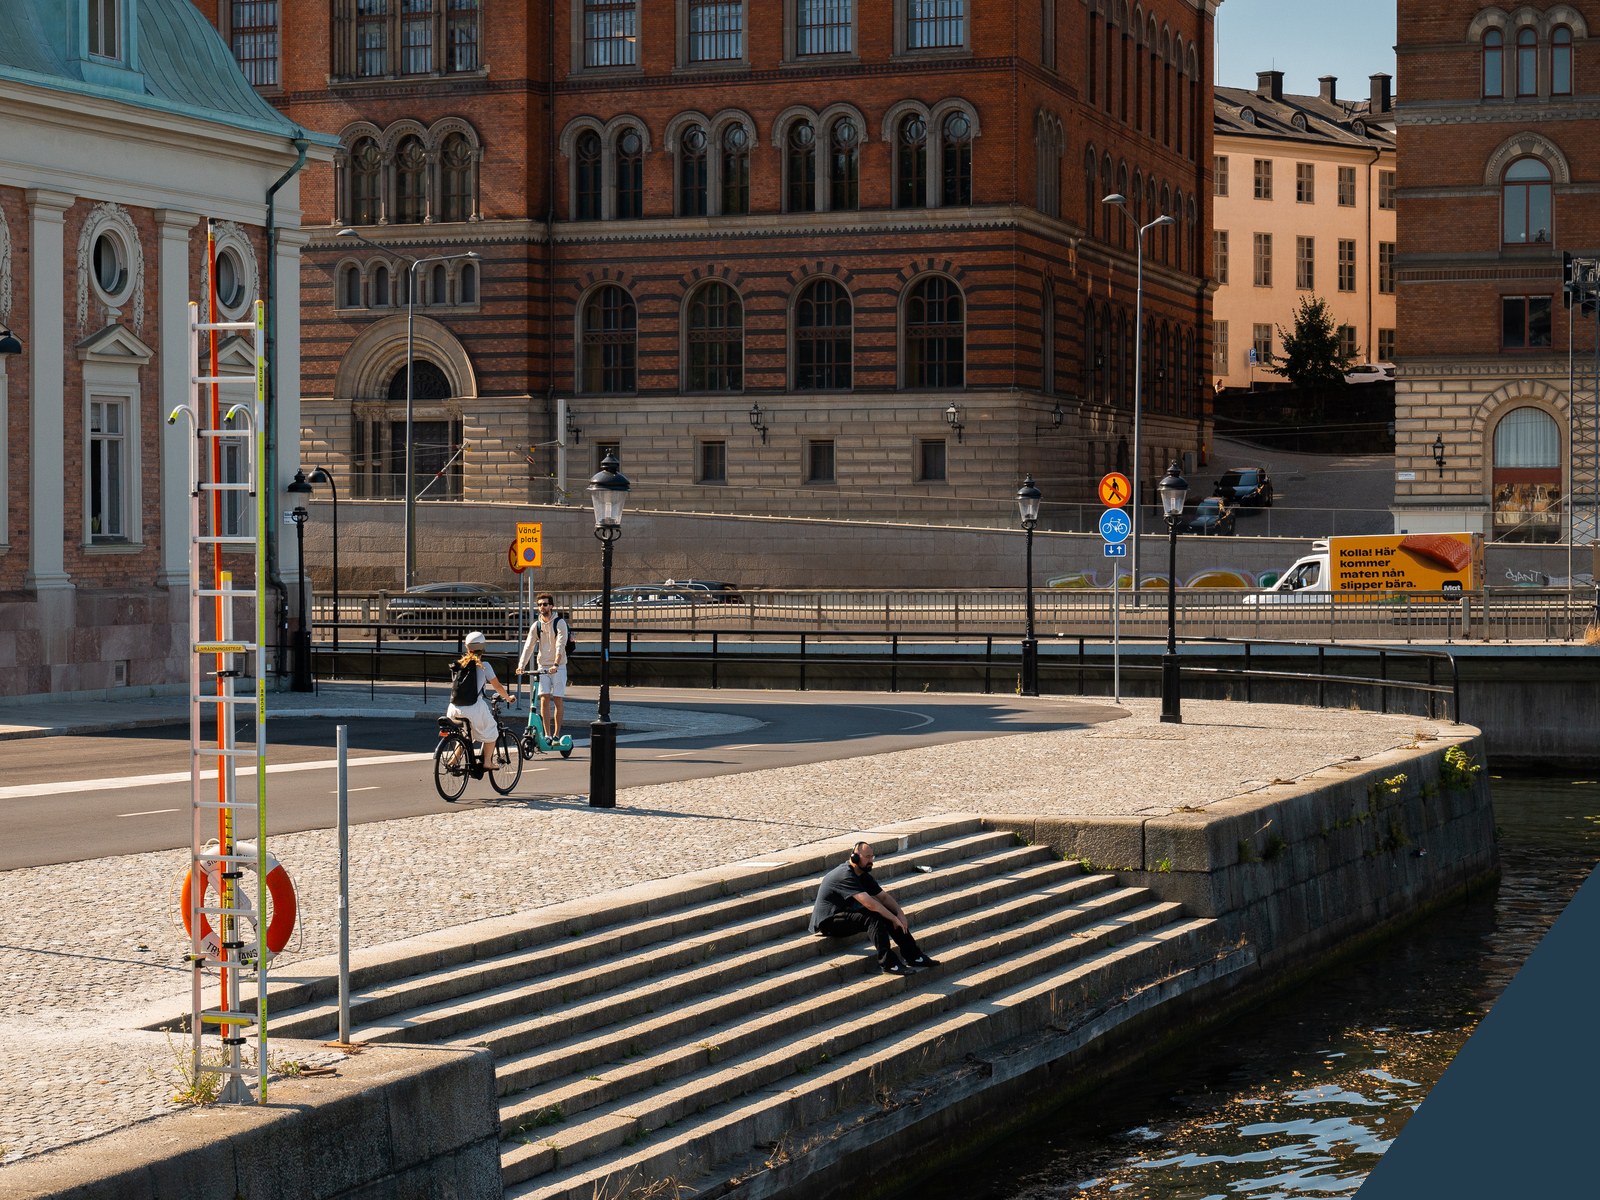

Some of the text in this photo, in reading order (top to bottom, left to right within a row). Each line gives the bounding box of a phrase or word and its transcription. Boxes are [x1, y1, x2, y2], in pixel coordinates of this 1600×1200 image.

[1340, 547, 1396, 557] Kolla! Här
[1340, 568, 1405, 578] maten nån
[1340, 579, 1417, 590] slipper bära.
